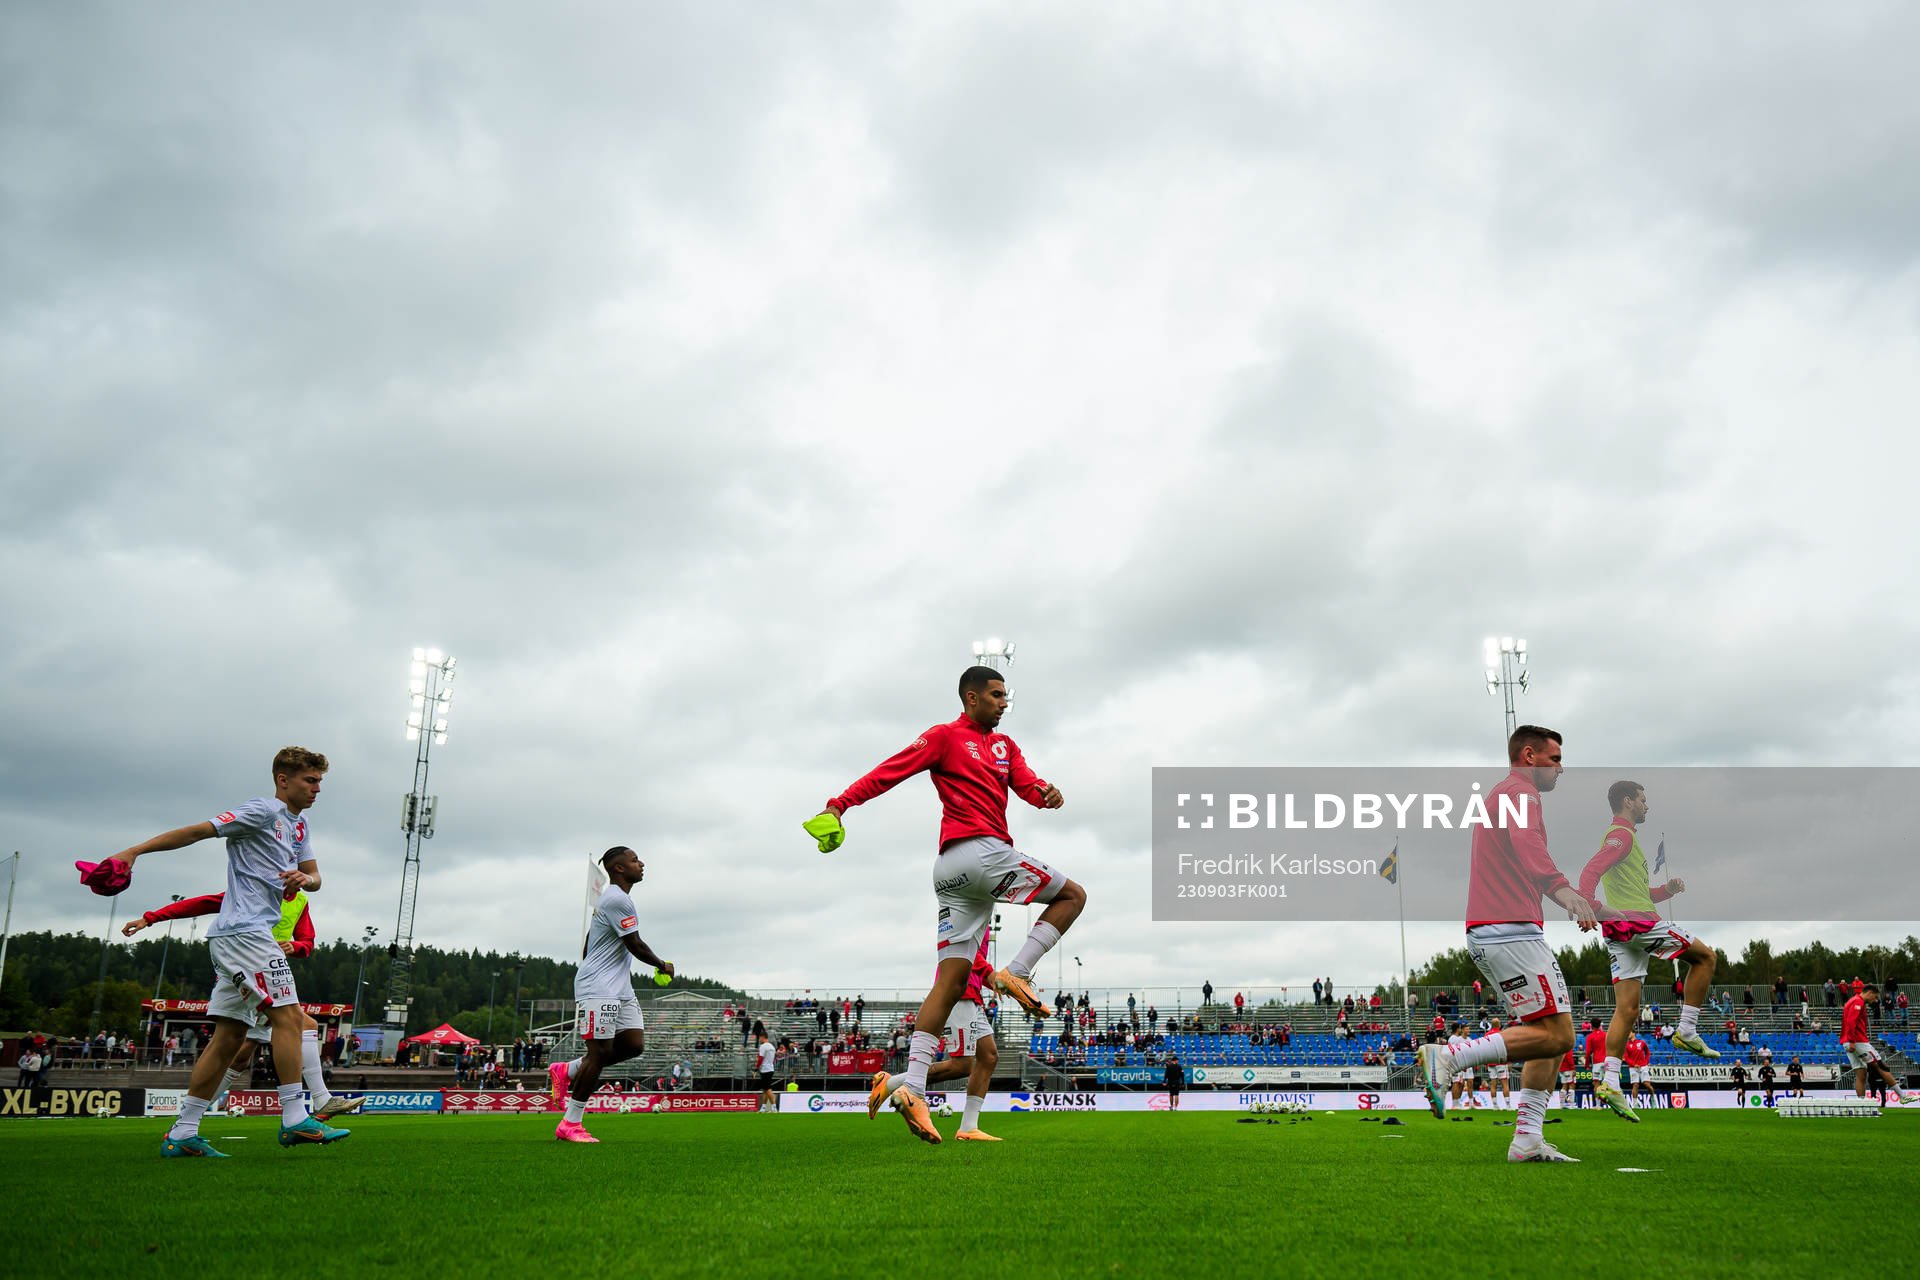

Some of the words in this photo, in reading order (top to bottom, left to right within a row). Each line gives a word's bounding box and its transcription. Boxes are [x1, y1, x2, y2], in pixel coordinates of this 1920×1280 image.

[1110, 1069, 1152, 1081] bravida
[1678, 1067, 1708, 1077] KMAB
[0, 1088, 122, 1115] XL-BYGG
[147, 1092, 177, 1105] Toroma
[229, 1095, 262, 1107] D-LAB
[672, 1098, 756, 1108] BCHOTELS.SE
[1033, 1093, 1096, 1106] SVENSK
